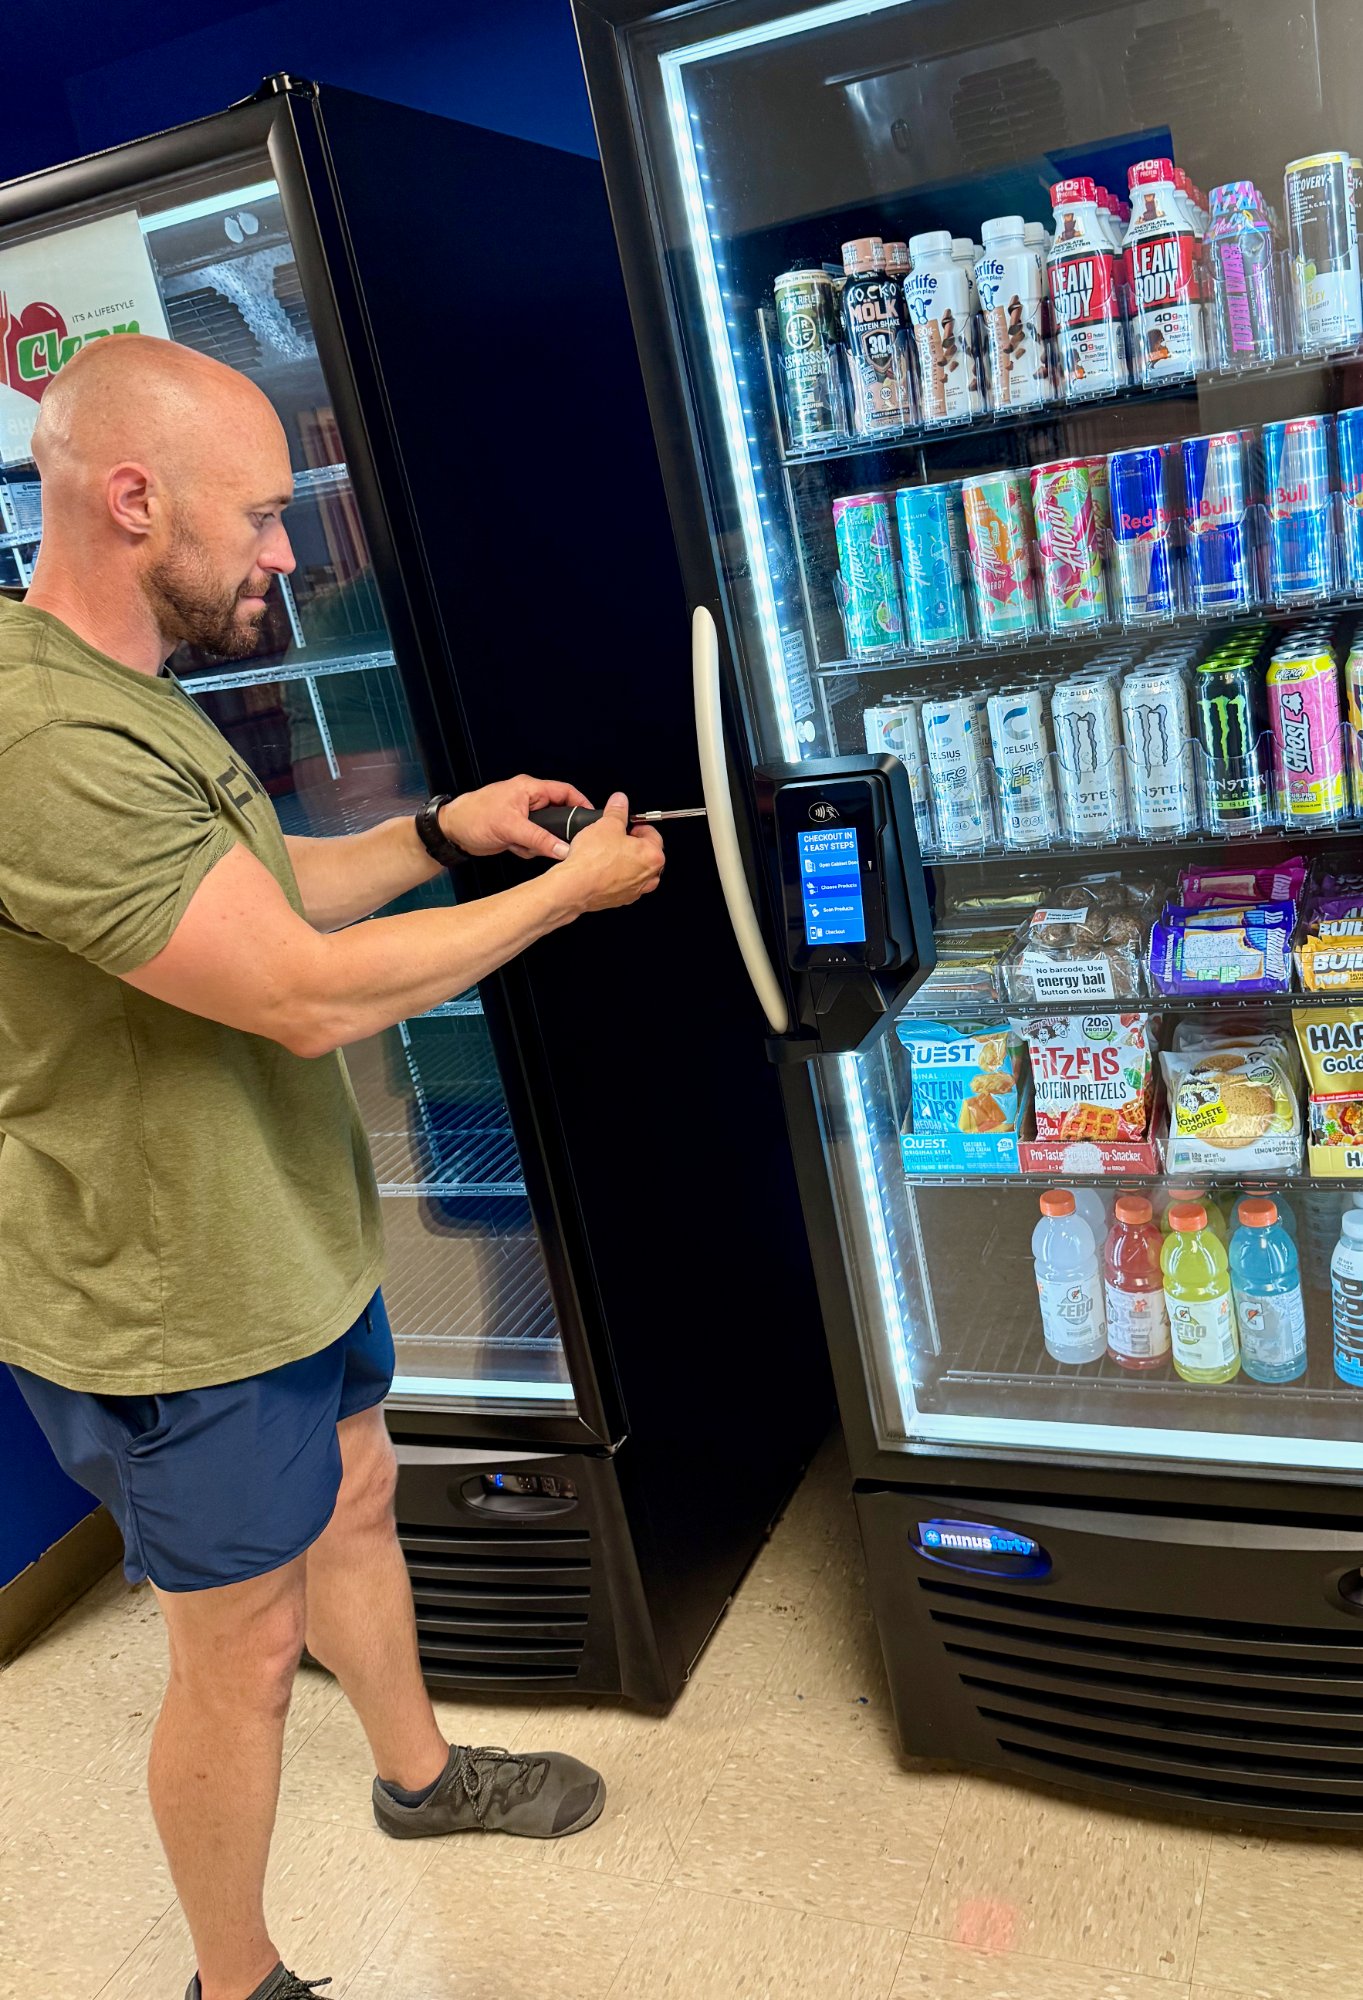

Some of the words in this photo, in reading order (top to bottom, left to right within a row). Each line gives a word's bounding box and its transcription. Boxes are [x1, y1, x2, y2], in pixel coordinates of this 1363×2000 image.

[1132, 240, 1179, 279] LEAN
[1051, 260, 1094, 298] LEAN
[1134, 270, 1179, 307] BODY
[71, 314, 86, 325] IT'S
[87, 311, 94, 320] A
[94, 299, 136, 317] LIFESTYLE
[850, 298, 899, 323] MÖLK
[1154, 312, 1178, 325] 40g
[1163, 323, 1179, 334] 0g
[1071, 332, 1093, 343] 40g
[17, 319, 141, 382] Cle
[1080, 343, 1094, 353] 0g
[1274, 484, 1308, 504] Bull
[1199, 498, 1233, 517] Bull
[1120, 511, 1154, 530] Red
[986, 579, 1006, 593] NERGY
[1069, 687, 1099, 698] SUGAR
[1140, 679, 1171, 690] SUGAR
[1002, 741, 1039, 755] CELSIUS
[898, 751, 917, 762] SIUS
[1010, 757, 1045, 777] STRO
[1205, 774, 1266, 792] ONSTER
[1082, 811, 1108, 819] ULTRA
[1152, 806, 1178, 814] ULTRA
[803, 832, 843, 843] CHECKOUT
[844, 831, 853, 840] IN
[810, 843, 829, 852] EASY
[830, 841, 855, 851] STEPS
[1319, 921, 1363, 937] BUIL
[1036, 967, 1048, 975] No
[1049, 965, 1086, 974] barcode.
[1314, 954, 1363, 971] BUIL
[1036, 976, 1079, 989] energy
[1081, 972, 1106, 986] ball
[1041, 988, 1069, 996] button
[1083, 986, 1107, 994] kiosk
[1087, 1017, 1109, 1028] 20G
[1308, 1023, 1363, 1053] HAR
[912, 1080, 964, 1101] ROTEIN
[1036, 1081, 1071, 1100] ROTEIN
[1073, 1081, 1127, 1101] PRETZELS
[914, 1119, 942, 1132] HEDDAR
[1186, 1117, 1217, 1133] COOKIE
[902, 1137, 948, 1149] QUEST
[1100, 1148, 1144, 1162] ro-Snacker.
[1056, 1297, 1094, 1318] ZERO
[1174, 1323, 1207, 1340] ERO
